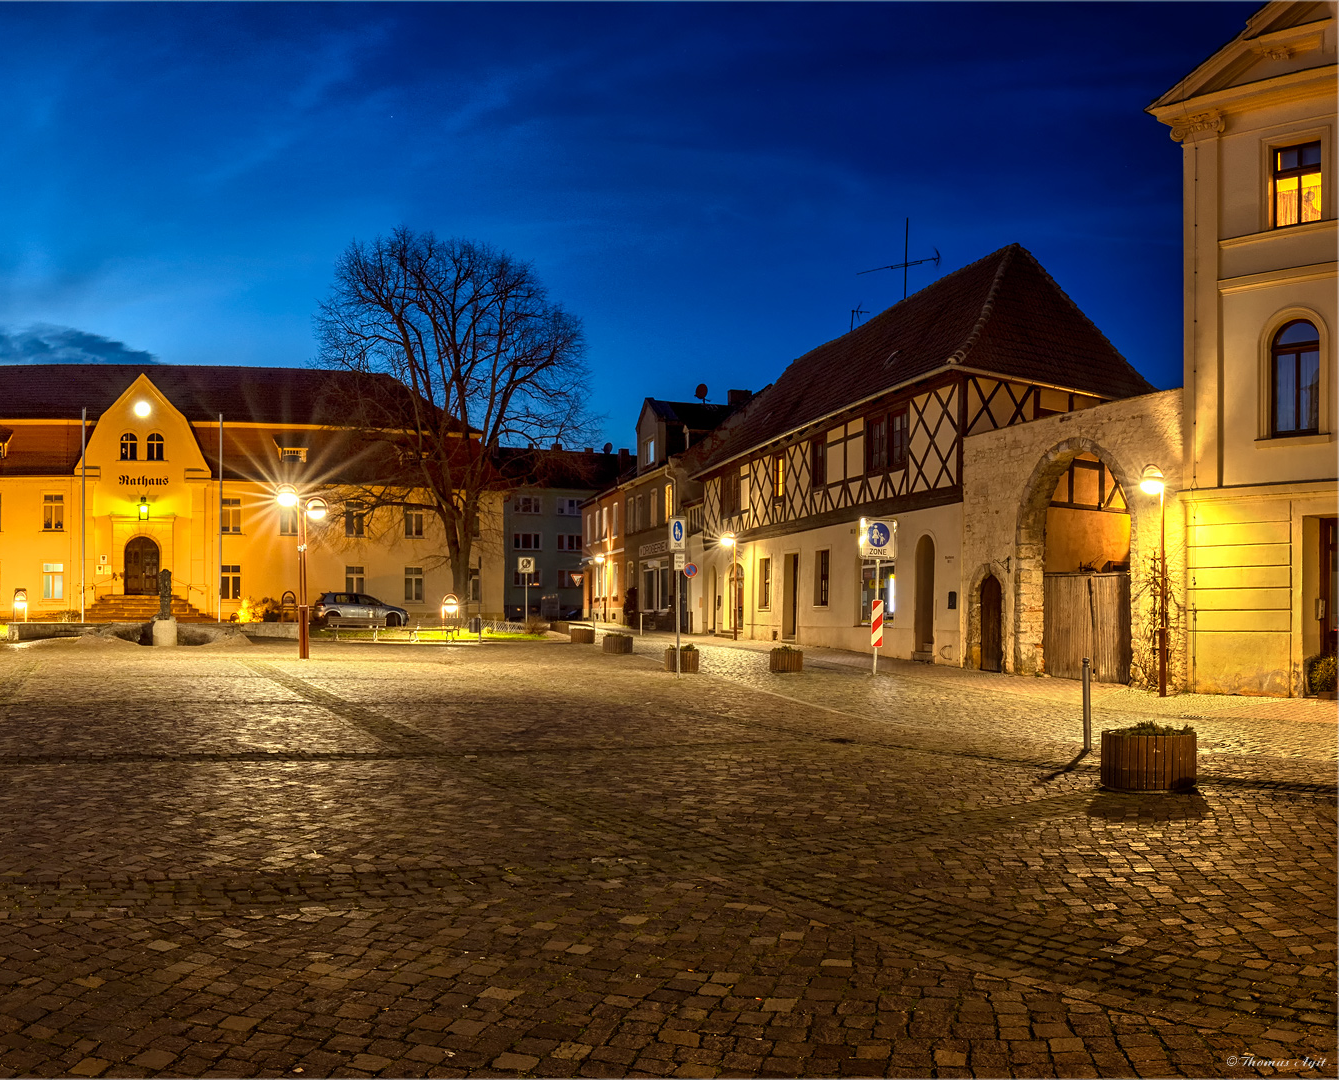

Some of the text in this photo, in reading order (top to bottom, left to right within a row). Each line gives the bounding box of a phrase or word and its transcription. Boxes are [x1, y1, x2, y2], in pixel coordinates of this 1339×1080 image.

[119, 475, 169, 488] Rathaus
[643, 542, 665, 556] DROGERIE
[869, 548, 887, 556] ZONE
